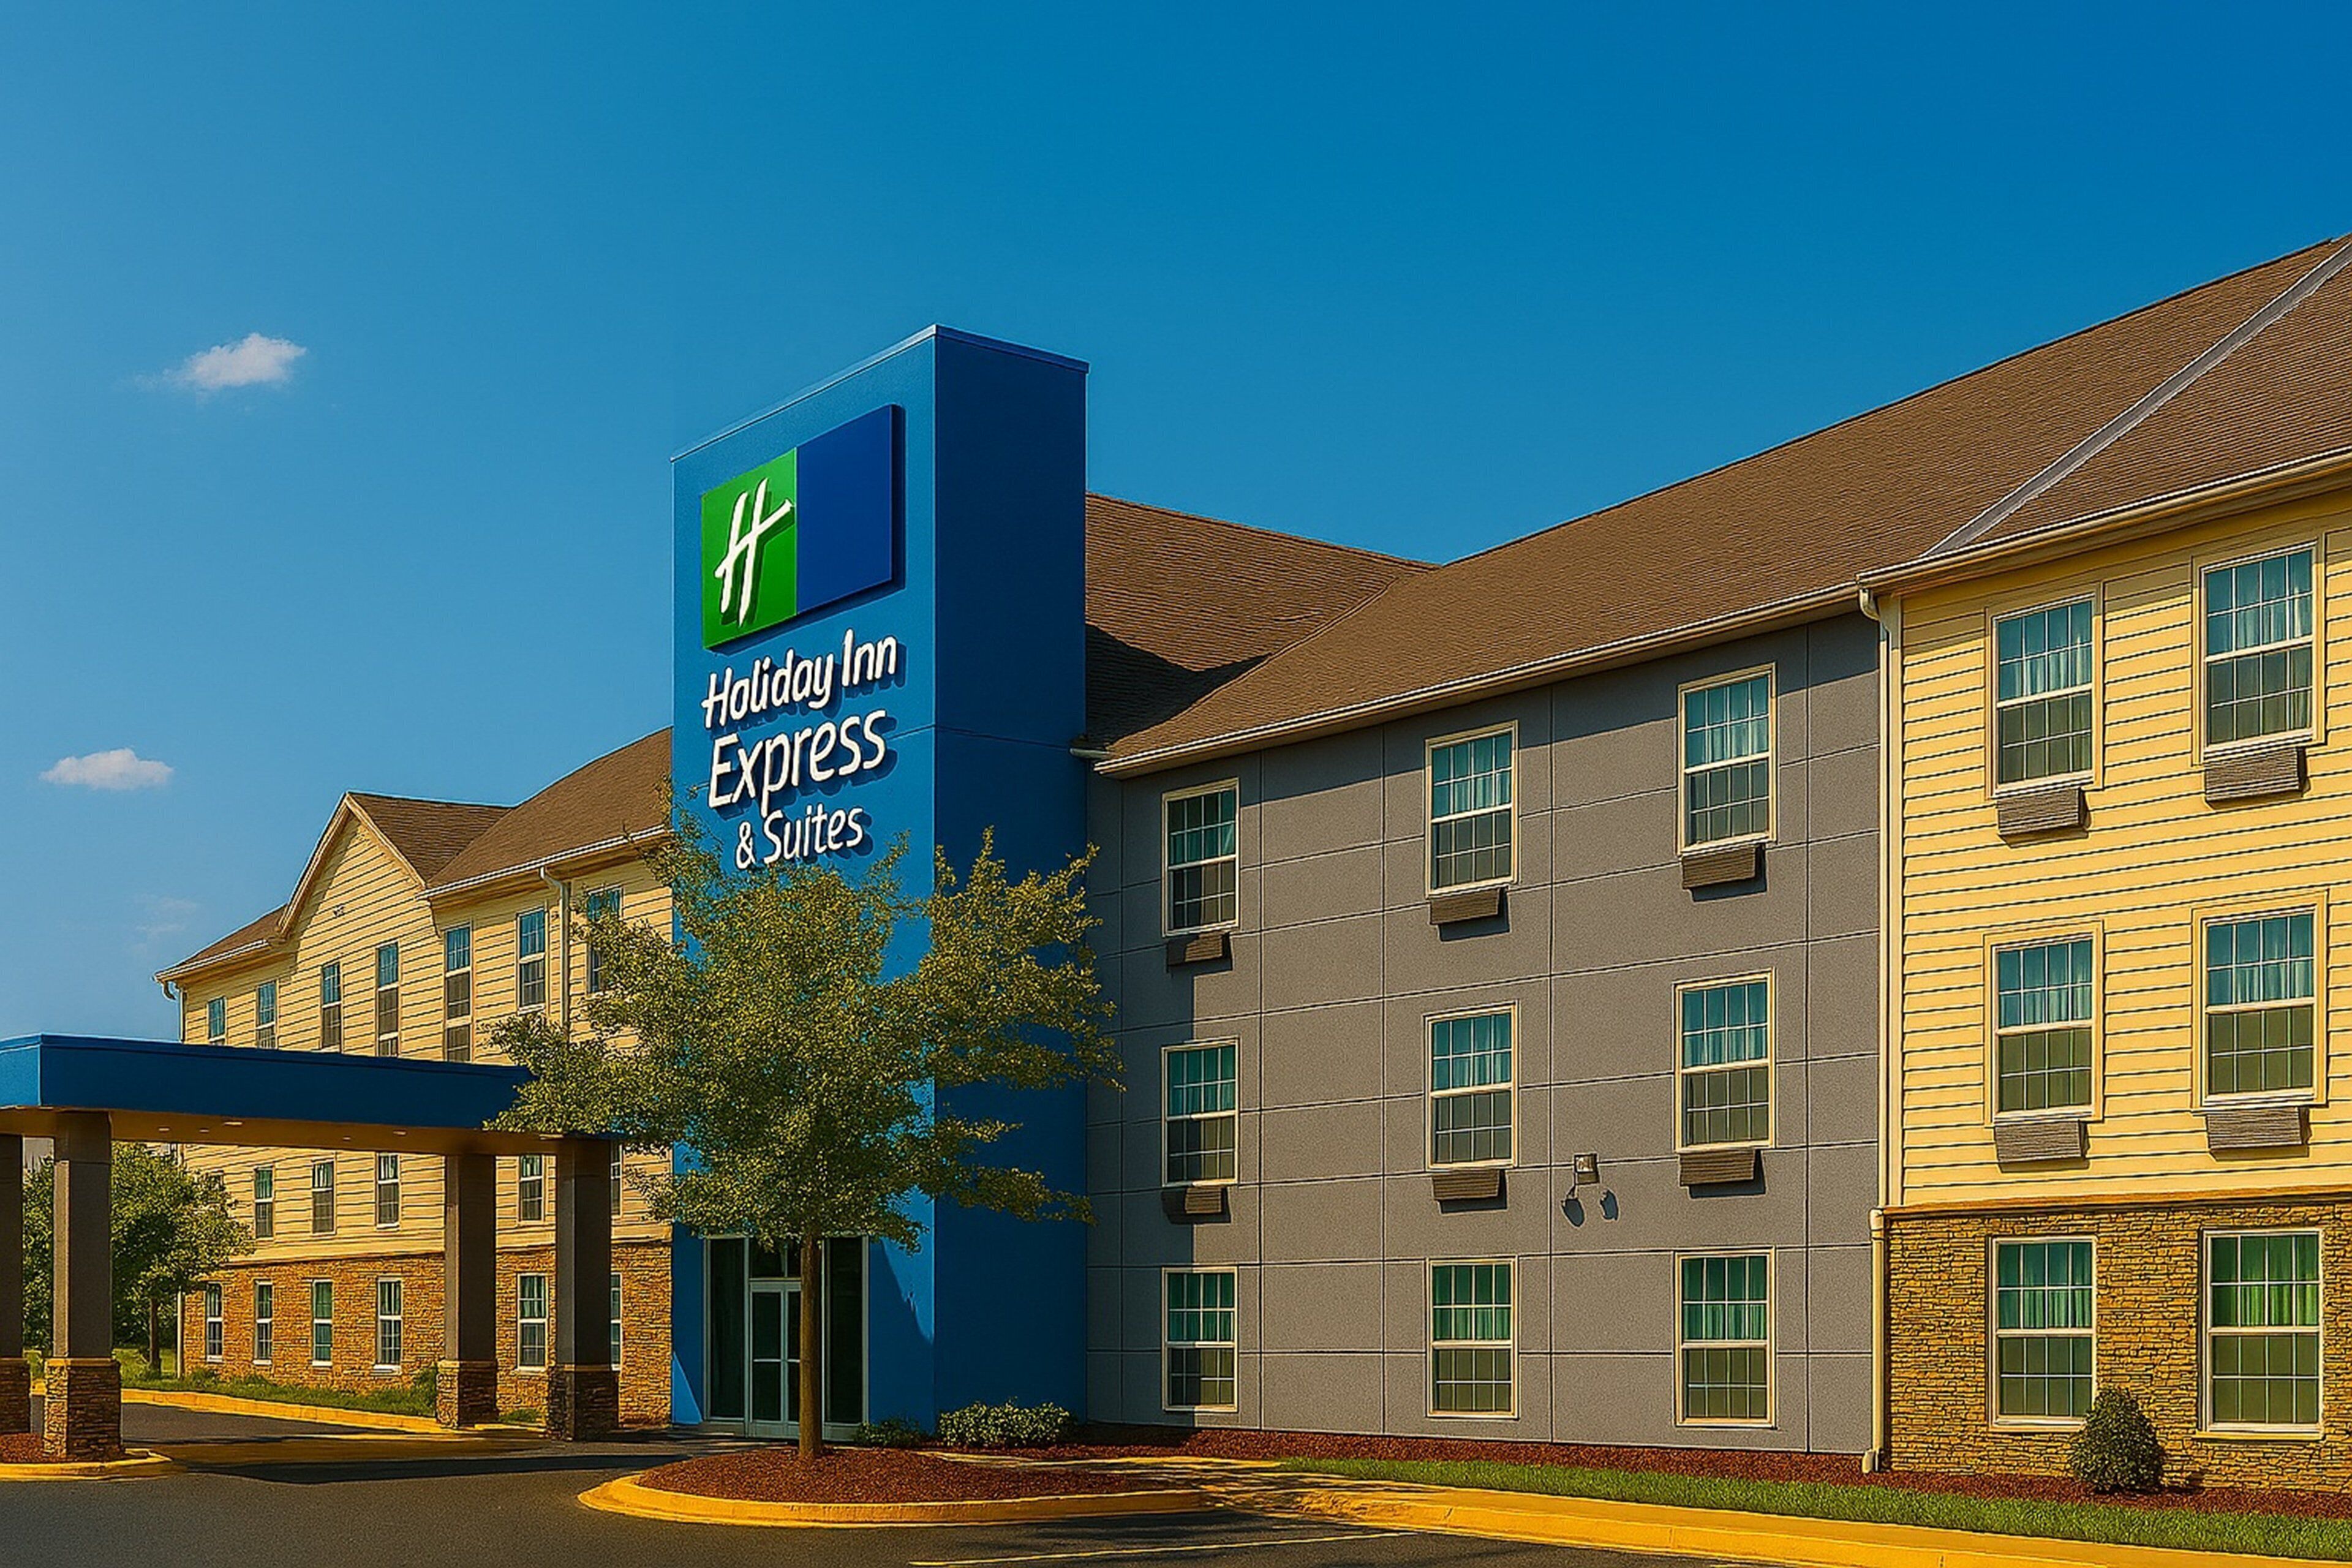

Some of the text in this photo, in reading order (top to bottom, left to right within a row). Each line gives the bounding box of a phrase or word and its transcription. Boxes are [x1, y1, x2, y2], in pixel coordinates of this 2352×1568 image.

[700, 628, 897, 729] Holiday Inn
[708, 709, 886, 819] Express
[736, 804, 863, 869] & Suites
